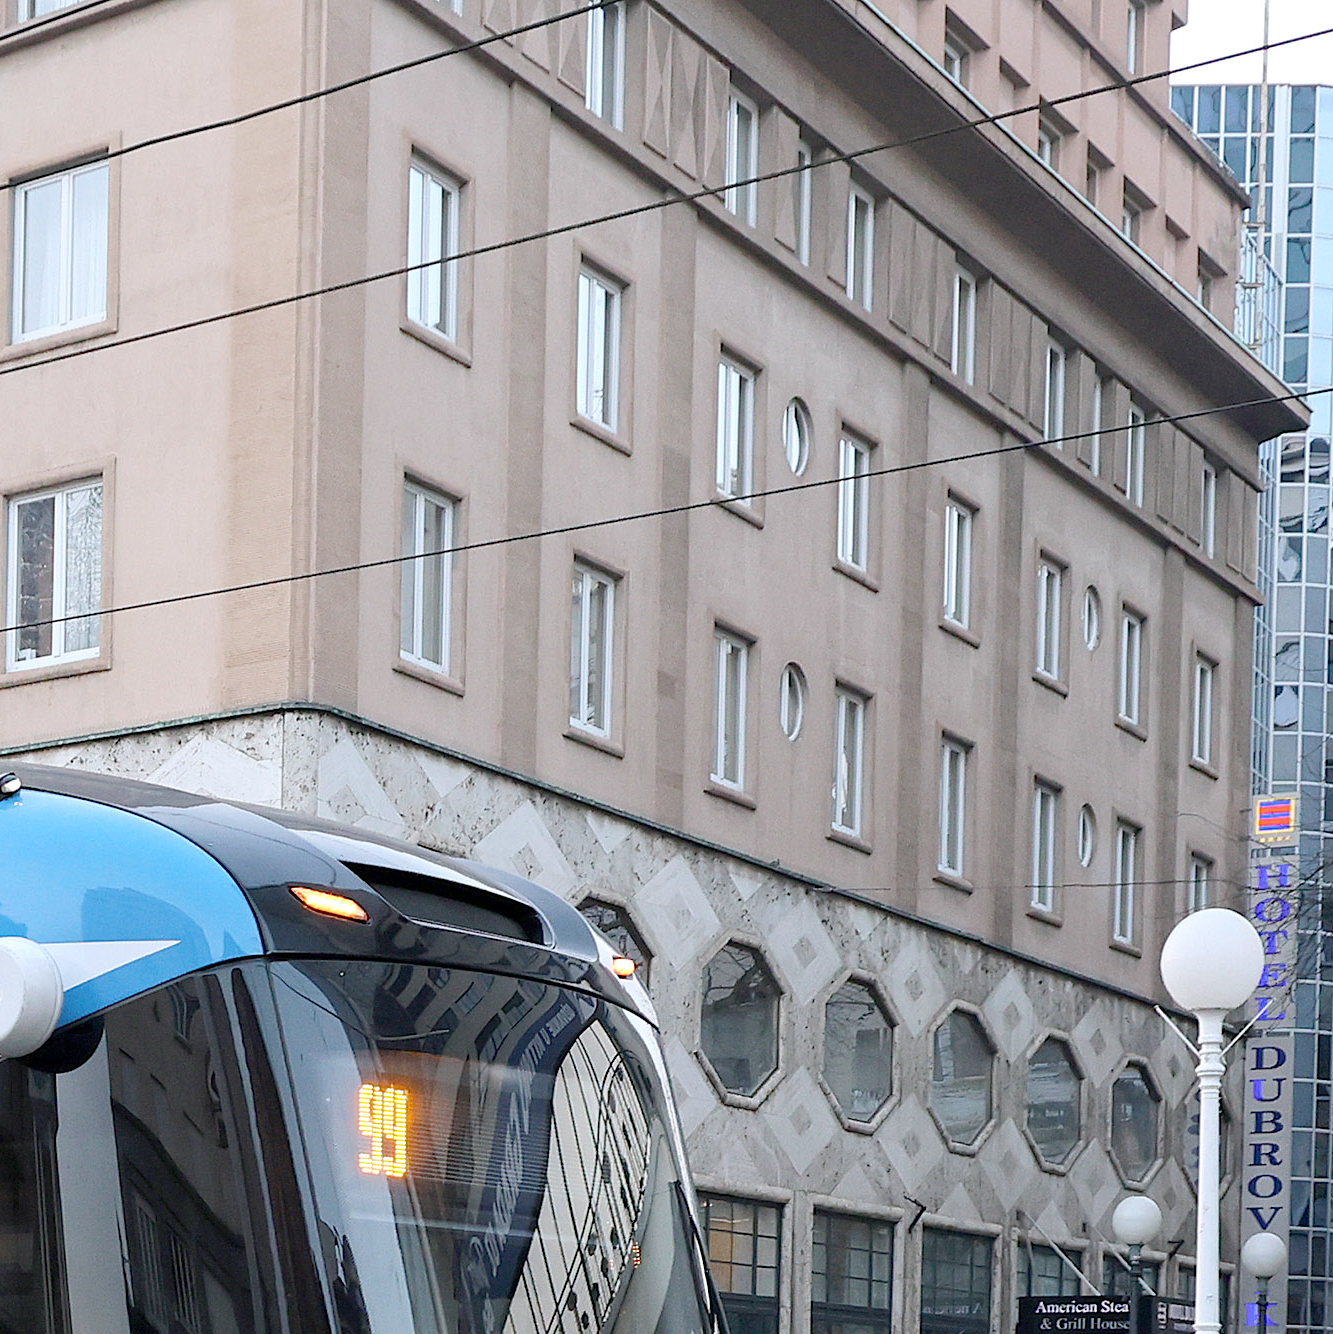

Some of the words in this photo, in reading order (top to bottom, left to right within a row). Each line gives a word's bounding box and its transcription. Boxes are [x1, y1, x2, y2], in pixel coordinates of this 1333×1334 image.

[1251, 863, 1293, 1022] HOTEL
[358, 1083, 408, 1178] 99
[1242, 1045, 1288, 1328] DUBROVK
[1035, 1301, 1098, 1315] American
[1100, 1300, 1132, 1314] Stea
[1040, 1319, 1052, 1331] &
[1056, 1317, 1086, 1331] Grill
